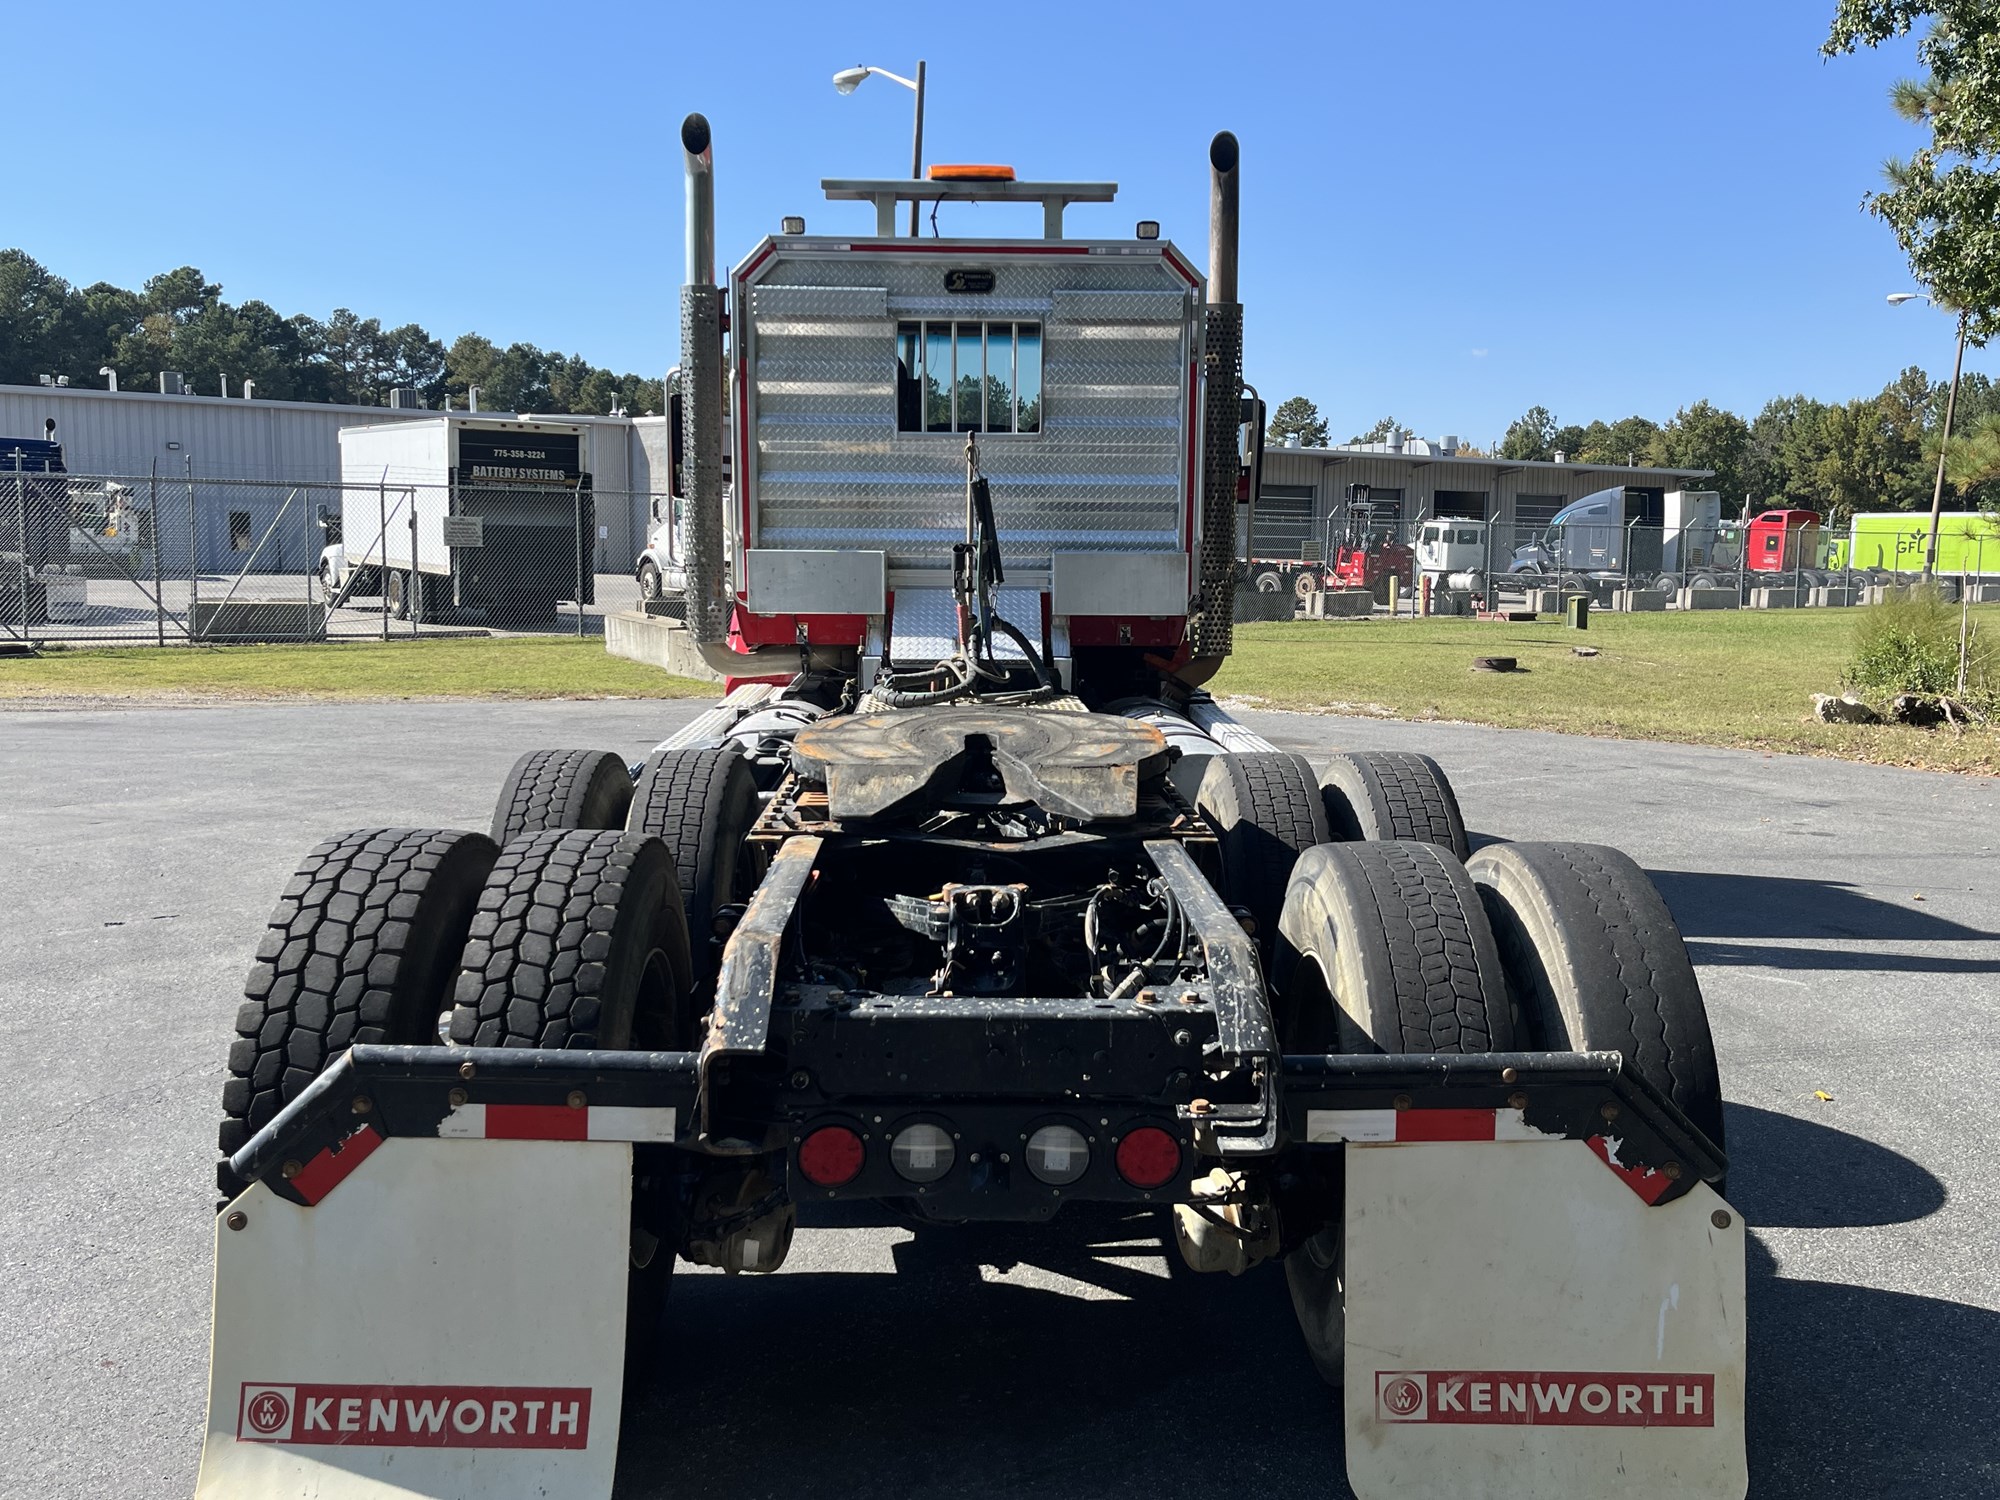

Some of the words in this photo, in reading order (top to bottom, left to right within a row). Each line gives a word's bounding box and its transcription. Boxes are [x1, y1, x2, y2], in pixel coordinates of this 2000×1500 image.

[493, 448, 546, 459] 775-358-3224
[472, 465, 518, 478] BATTERY
[519, 468, 565, 480] SYSTEMS
[1897, 535, 1925, 554] GFL
[1437, 1382, 1704, 1415] KENWORTH
[304, 1397, 580, 1436] KENWORTH
